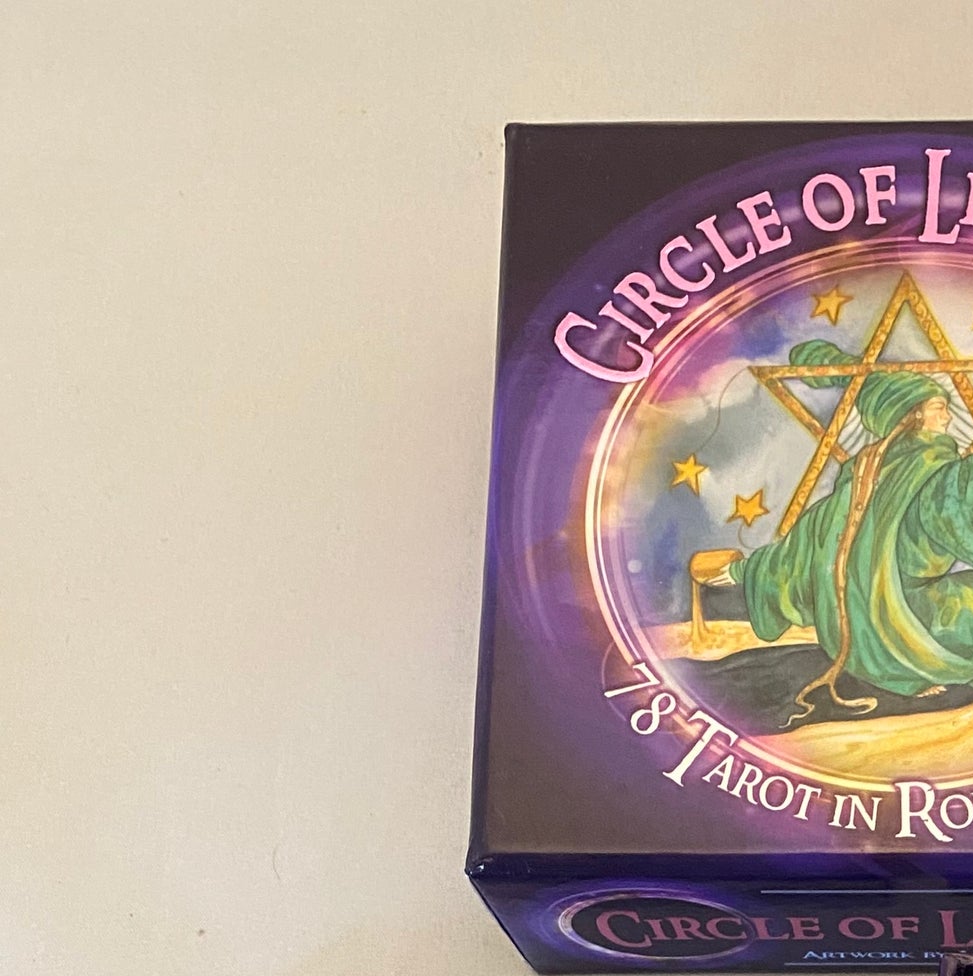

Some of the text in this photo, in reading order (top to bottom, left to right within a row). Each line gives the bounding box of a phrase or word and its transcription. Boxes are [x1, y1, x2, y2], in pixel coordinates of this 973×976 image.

[552, 191, 792, 386] CIRCLE
[802, 165, 899, 234] OF
[662, 709, 829, 823] TAROT
[833, 794, 883, 831] IN
[595, 911, 826, 950] CIRCLE
[838, 911, 920, 940] OF
[803, 951, 916, 960] ARTWORK
